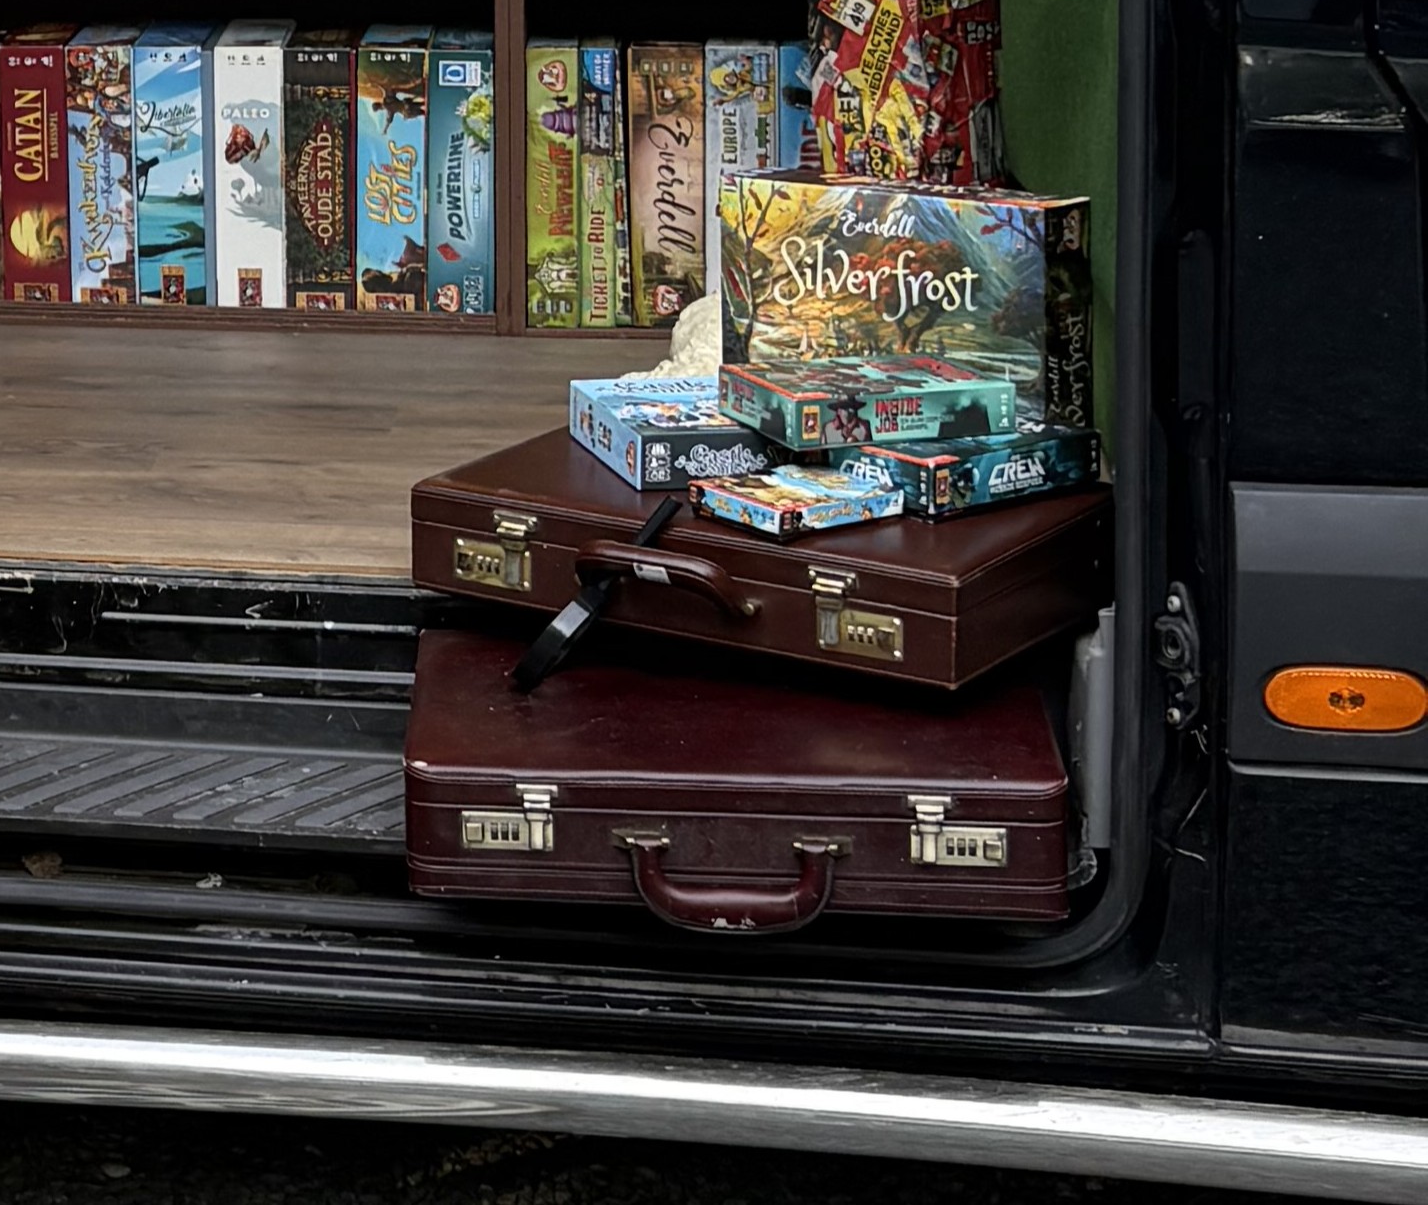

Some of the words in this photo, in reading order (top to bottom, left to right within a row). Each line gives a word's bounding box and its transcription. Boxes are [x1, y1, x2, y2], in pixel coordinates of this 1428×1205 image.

[870, 6, 892, 56] ACTIES
[13, 88, 43, 183] CATAN
[139, 100, 197, 132] Libertalia
[222, 107, 270, 119] PALEO
[720, 107, 739, 166] EUROPE
[295, 138, 317, 232] TAVEERNEN
[365, 163, 393, 226] LOST
[390, 141, 418, 225] CITIES
[446, 131, 467, 242] POWERLINE
[536, 159, 552, 216] Everdell
[647, 115, 697, 255] Everdell
[588, 206, 606, 244] RIDE
[841, 208, 916, 241] Everdell
[595, 242, 606, 258] TO
[589, 258, 608, 323] TICKET
[875, 397, 924, 417] INSIDE
[875, 416, 900, 434] JOB
[841, 458, 894, 487] CREW
[989, 459, 1046, 486] CREW
